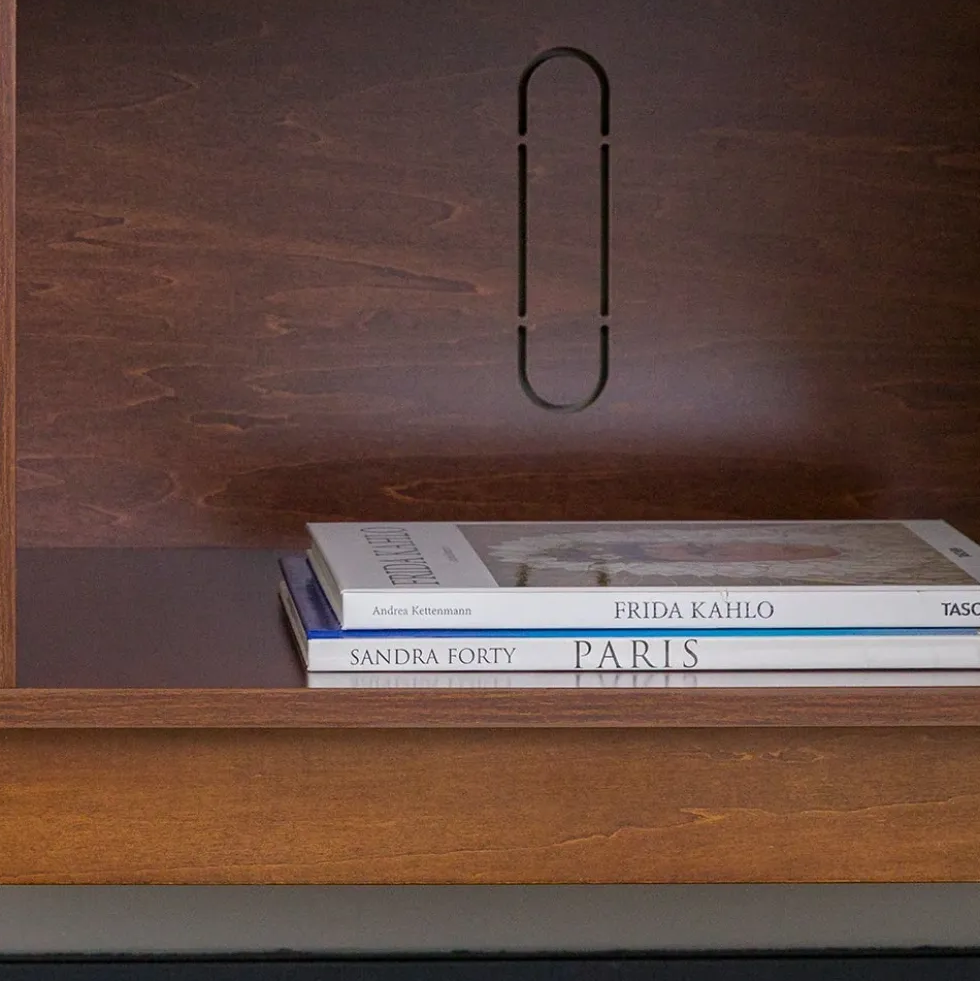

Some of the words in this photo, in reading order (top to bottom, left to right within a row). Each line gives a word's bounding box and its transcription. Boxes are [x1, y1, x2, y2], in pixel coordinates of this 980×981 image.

[372, 605, 409, 616] Andrea
[411, 605, 472, 616] Kettenmann
[614, 601, 683, 619] FRIDA
[691, 600, 775, 619] KAHLO
[941, 602, 980, 617] TASC
[350, 648, 439, 666] SANDRA
[448, 647, 516, 665] FORTY
[574, 638, 699, 669] PARIS
